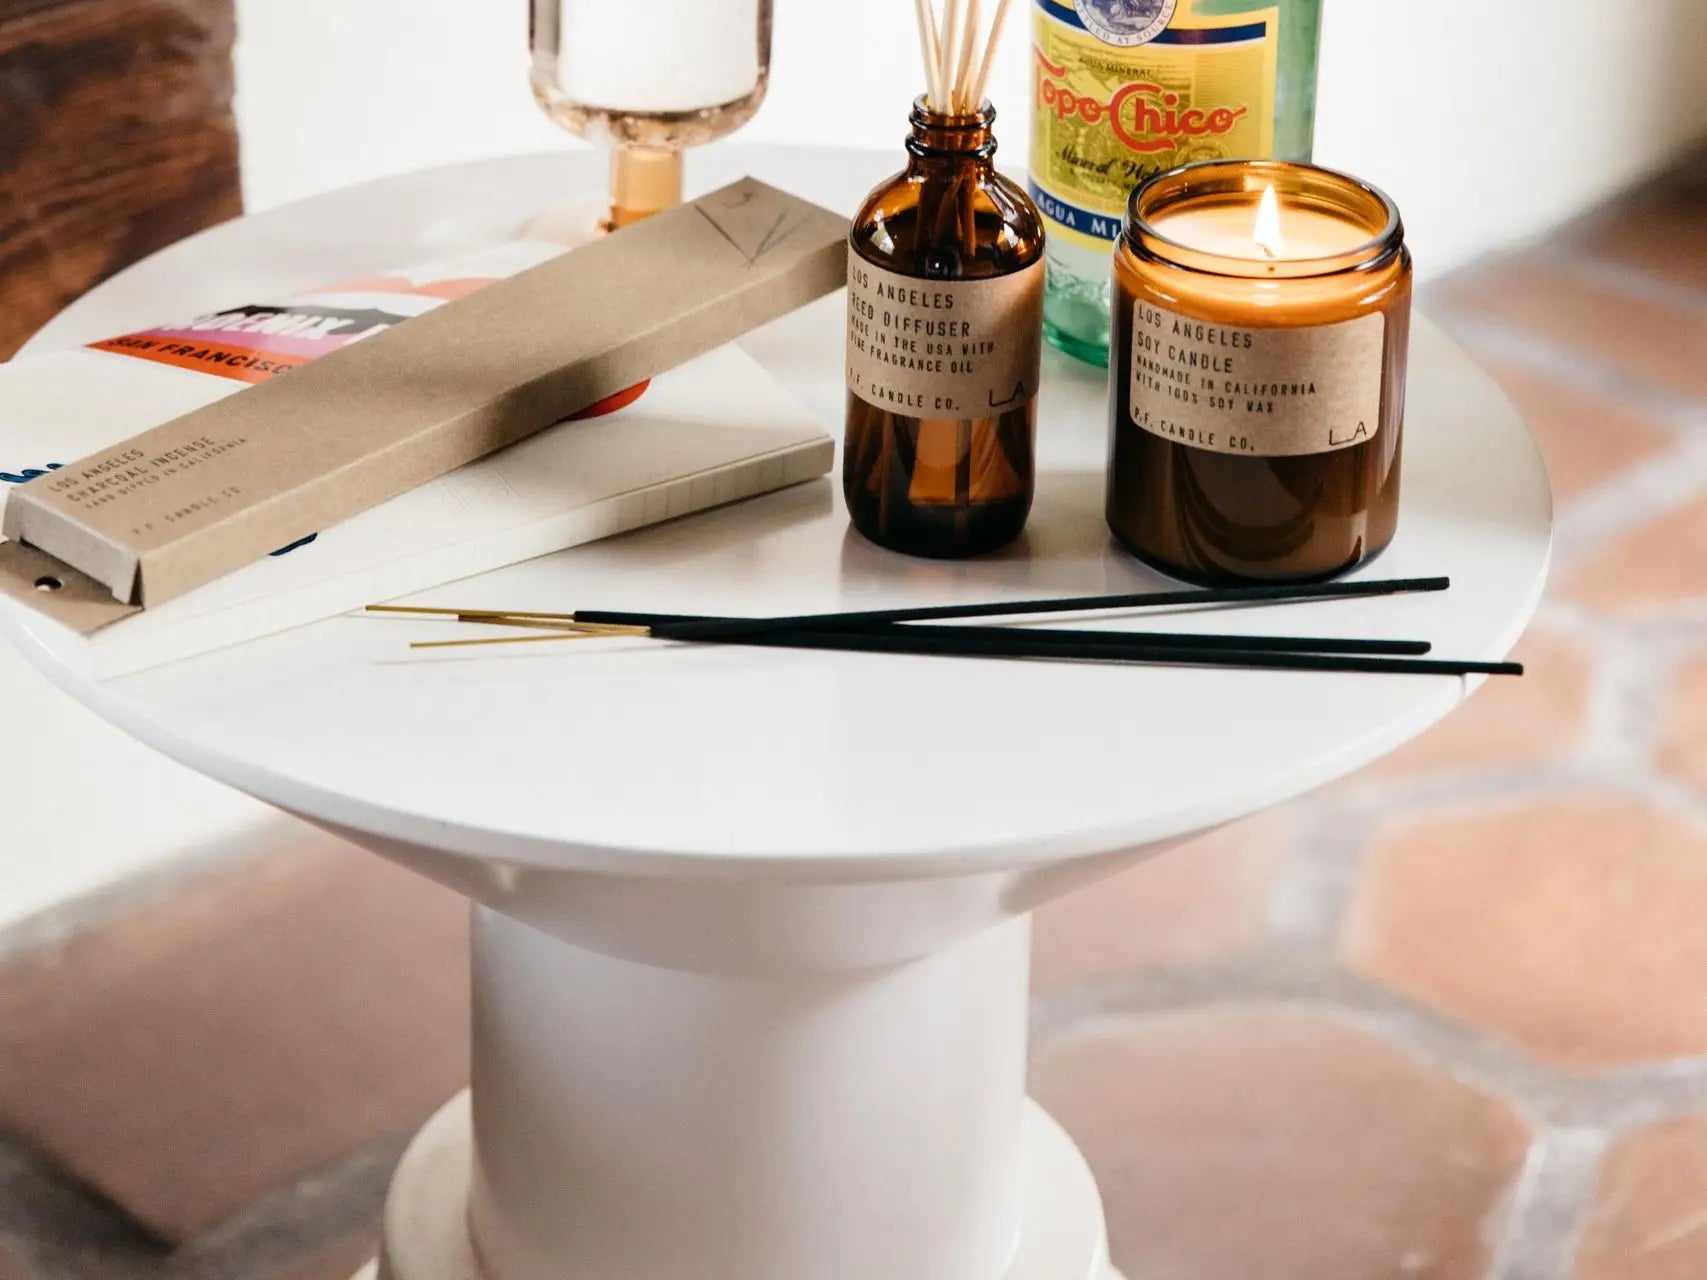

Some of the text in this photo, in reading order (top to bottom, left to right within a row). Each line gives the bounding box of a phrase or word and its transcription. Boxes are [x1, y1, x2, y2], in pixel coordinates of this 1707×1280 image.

[1109, 81, 1248, 154] Chico
[1037, 194, 1076, 227] AGUA
[852, 264, 954, 309] LOS ANGELES
[851, 292, 971, 337] REED DIFFUSER
[1138, 303, 1253, 350] LOS ANGELES
[870, 346, 943, 373] FRAGRANCE
[950, 362, 974, 374] OIL
[875, 330, 886, 345] IN
[894, 336, 917, 353] THE
[926, 344, 953, 356] USA
[962, 341, 995, 356] WITH
[1137, 331, 1234, 374] SOY CANDLE
[1135, 372, 1274, 414] WITH 100% SOY WAX
[1136, 354, 1316, 397] HANDMADE IN CALIFORNIA
[871, 384, 924, 409] CANDLE
[935, 397, 961, 411] CO.
[1134, 406, 1256, 452] P.F. CANDLE CO.
[66, 466, 149, 503] CHARCOAL
[150, 435, 216, 468] INCENSE
[81, 448, 145, 480] ANGELES
